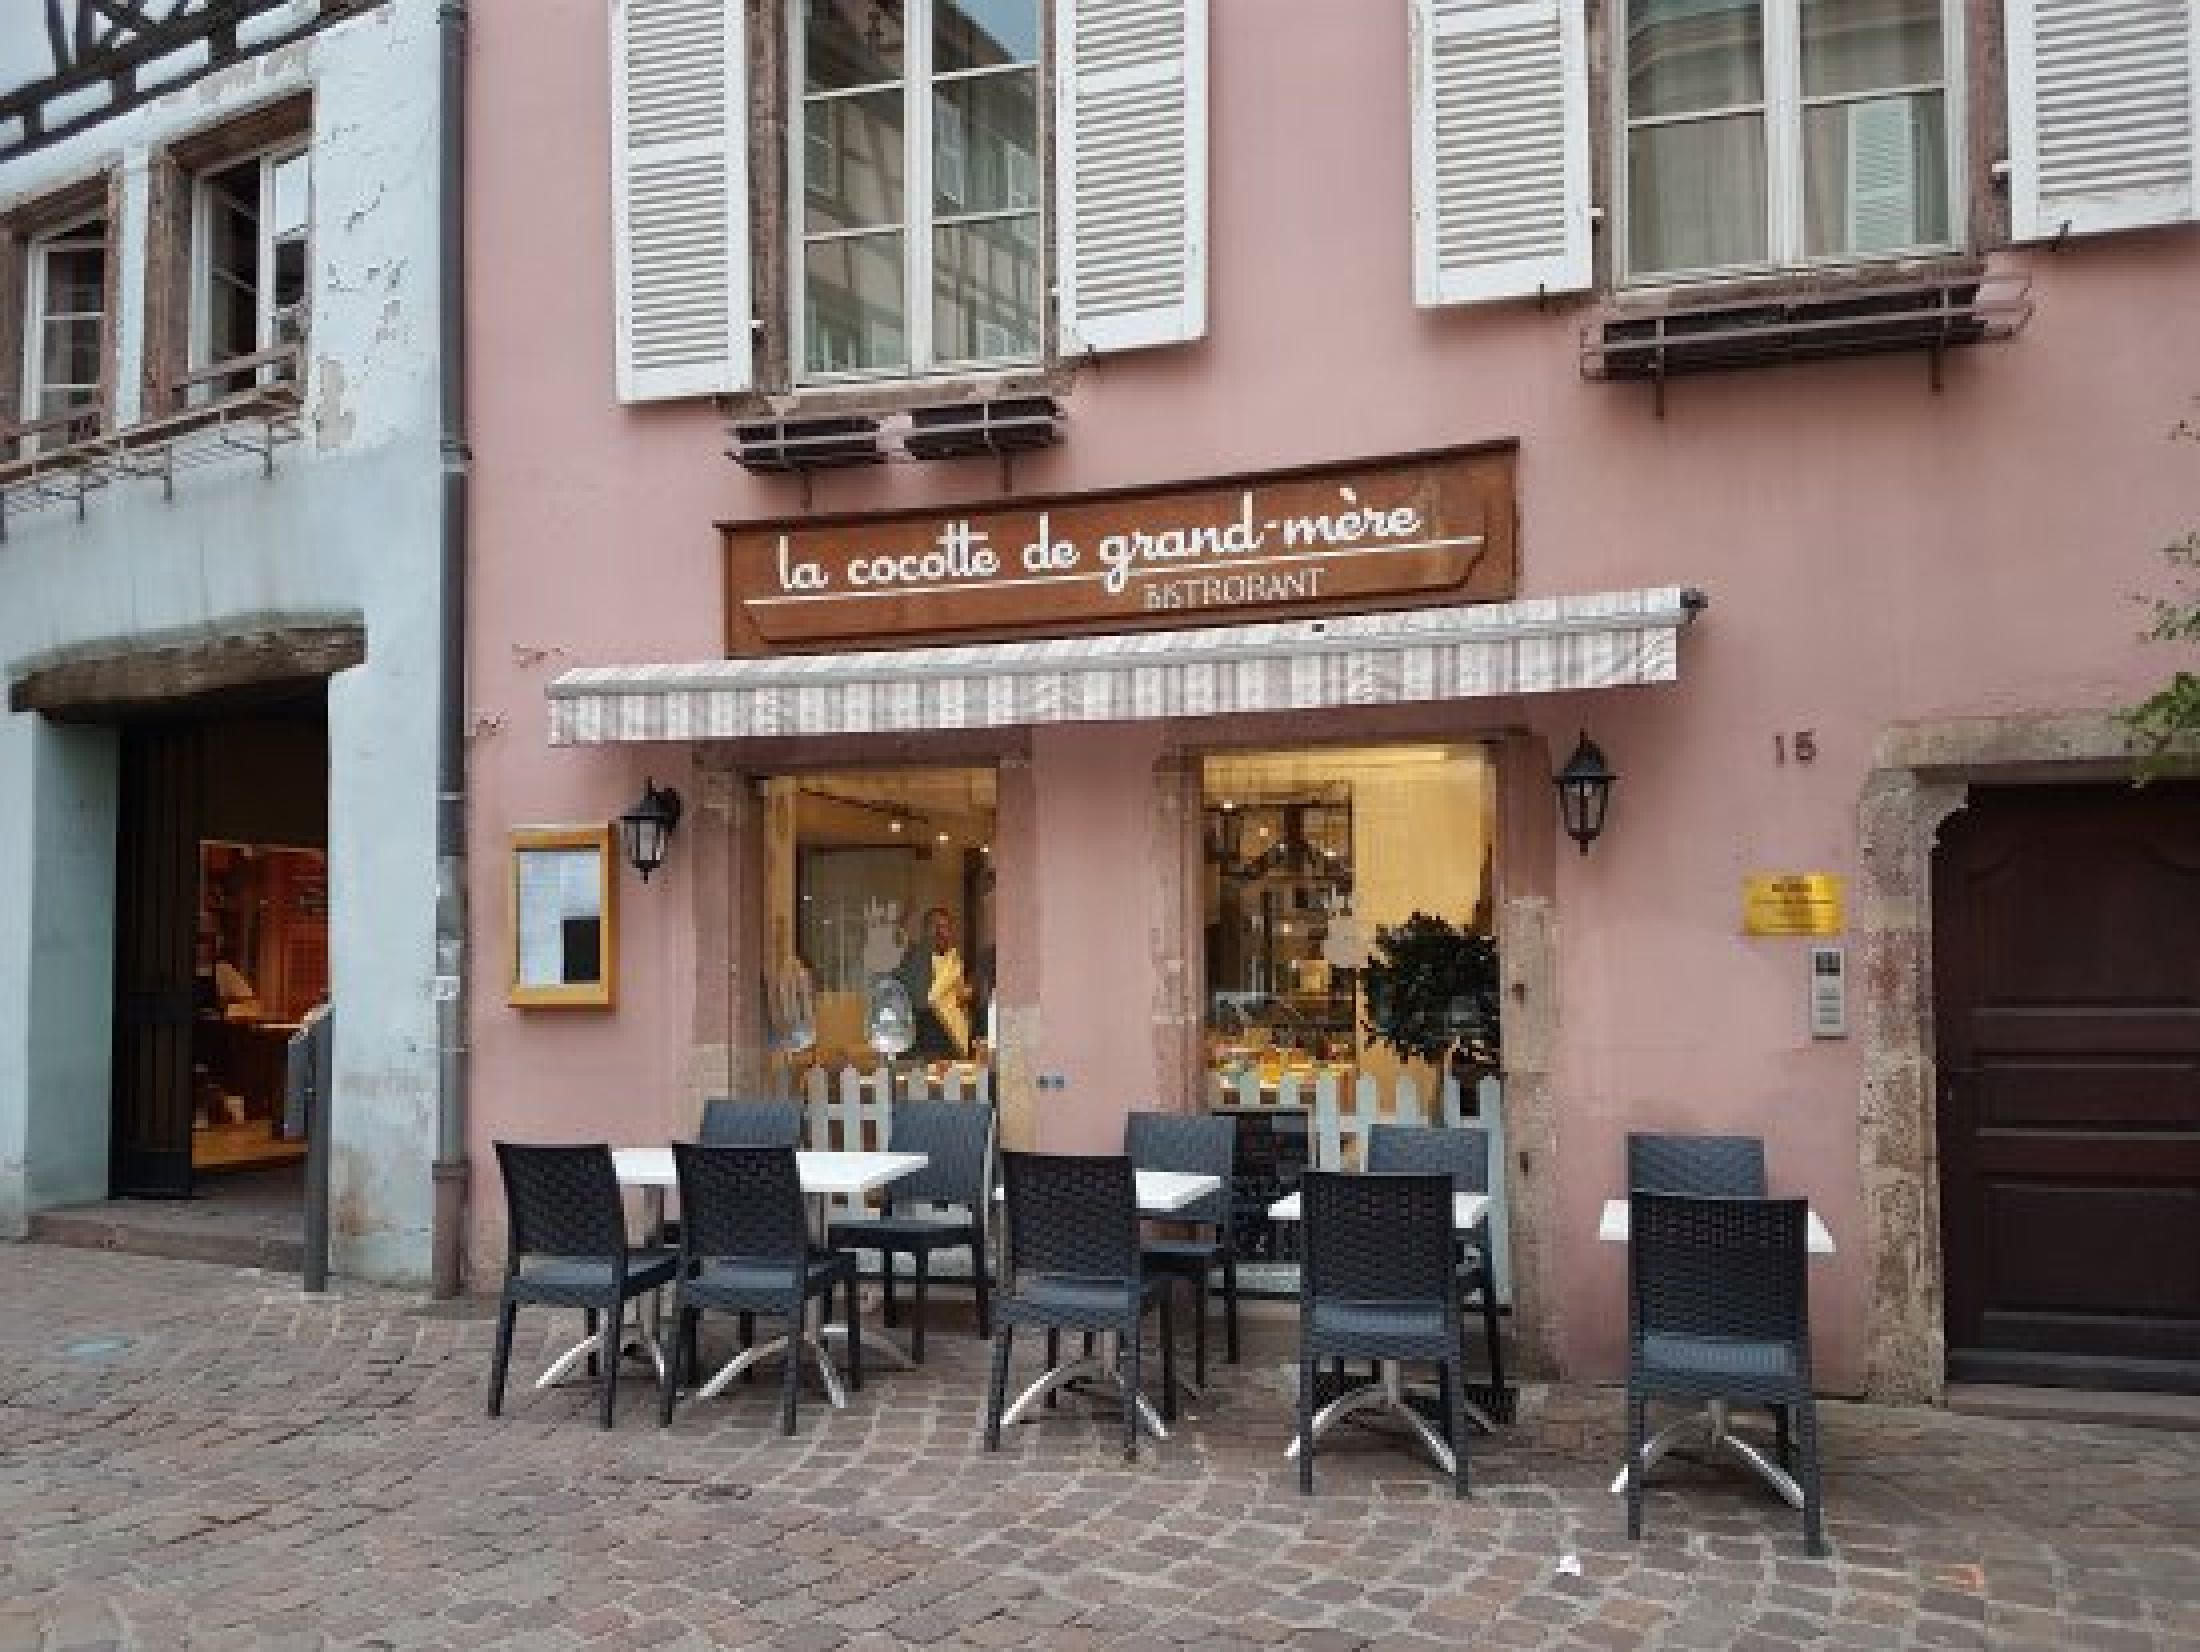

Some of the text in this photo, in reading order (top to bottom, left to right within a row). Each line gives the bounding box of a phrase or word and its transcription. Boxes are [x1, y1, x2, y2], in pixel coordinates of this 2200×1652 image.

[778, 487, 1421, 593] la cocotte de grand-mère
